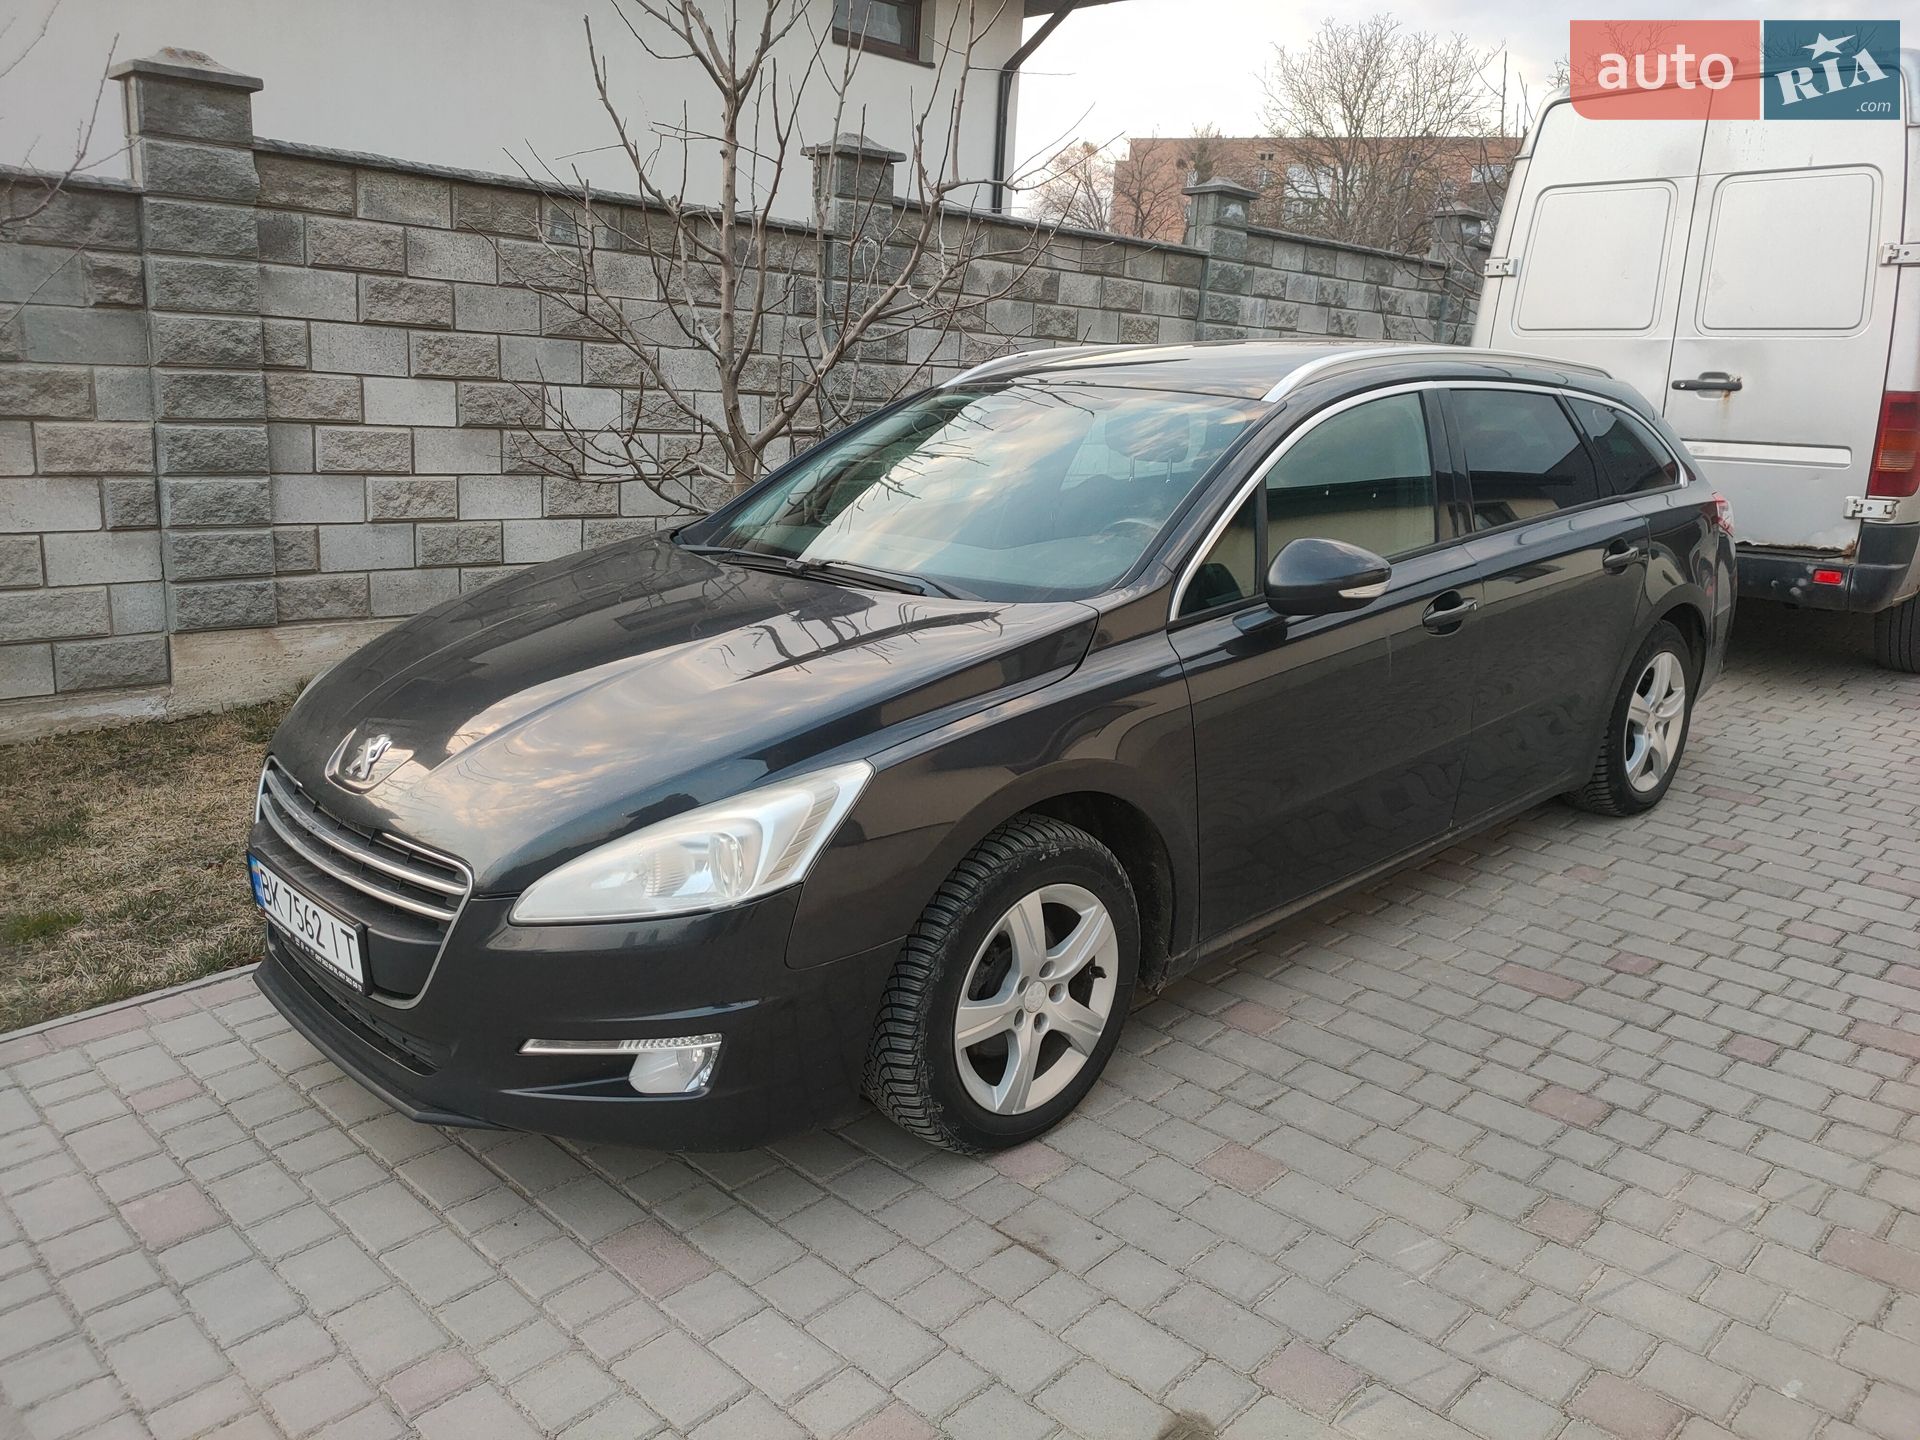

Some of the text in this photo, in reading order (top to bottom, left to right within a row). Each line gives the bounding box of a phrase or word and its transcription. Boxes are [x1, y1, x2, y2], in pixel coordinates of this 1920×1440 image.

[259, 868, 284, 917] BK
[283, 886, 326, 950] 7562
[330, 921, 355, 970] IT
